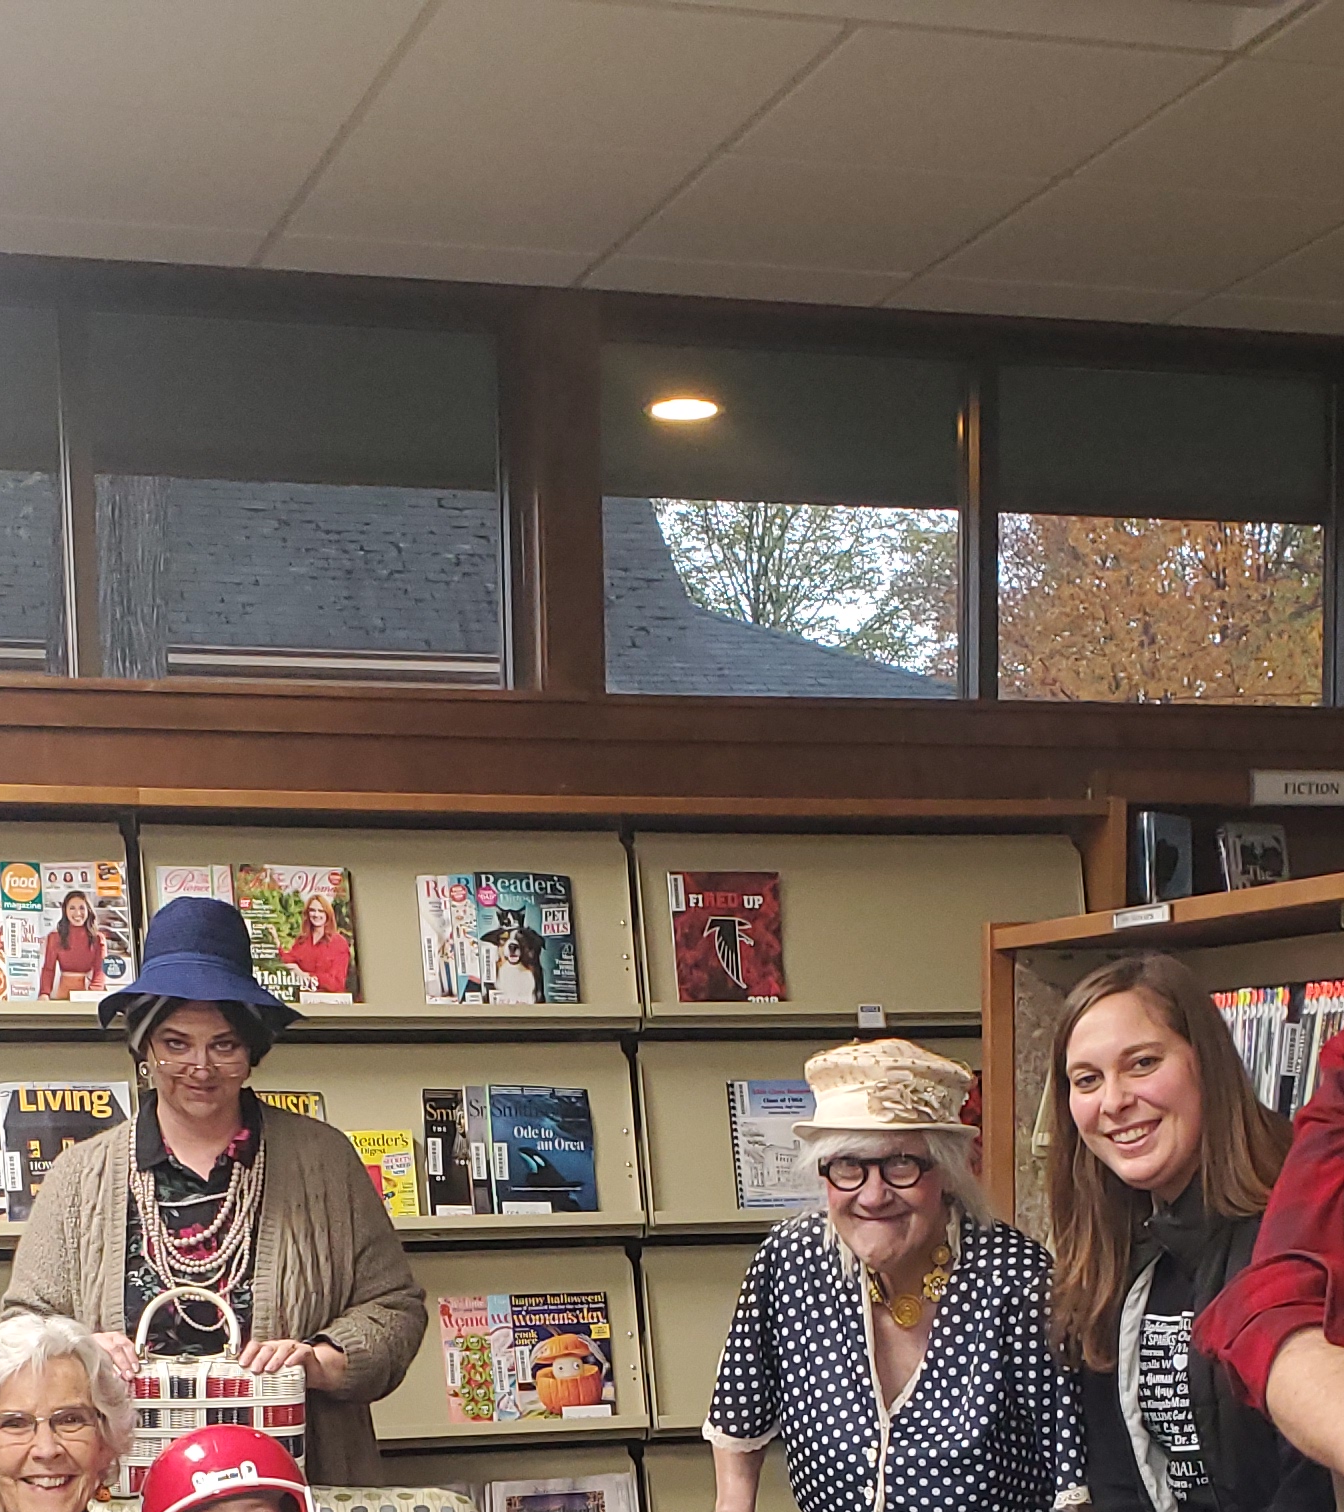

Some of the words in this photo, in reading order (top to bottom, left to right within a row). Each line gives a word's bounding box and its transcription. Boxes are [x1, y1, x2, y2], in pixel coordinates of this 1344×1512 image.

[1284, 782, 1340, 796] FICTION
[3, 866, 41, 893] food
[481, 873, 567, 896] Reader's
[3, 901, 42, 911] magazine
[743, 895, 764, 909] UP
[544, 909, 567, 922] PET
[543, 923, 569, 935] PALS
[18, 1085, 112, 1119] Living
[513, 1125, 540, 1139] Ode
[541, 1127, 554, 1139] to
[536, 1139, 553, 1151] an
[554, 1138, 585, 1151] Orca
[360, 1147, 387, 1156] Digest
[512, 1295, 545, 1307] happy
[546, 1292, 605, 1305] halloween!
[515, 1329, 538, 1339] cook
[515, 1338, 538, 1346] once
[1174, 1435, 1190, 1445] Dr.
